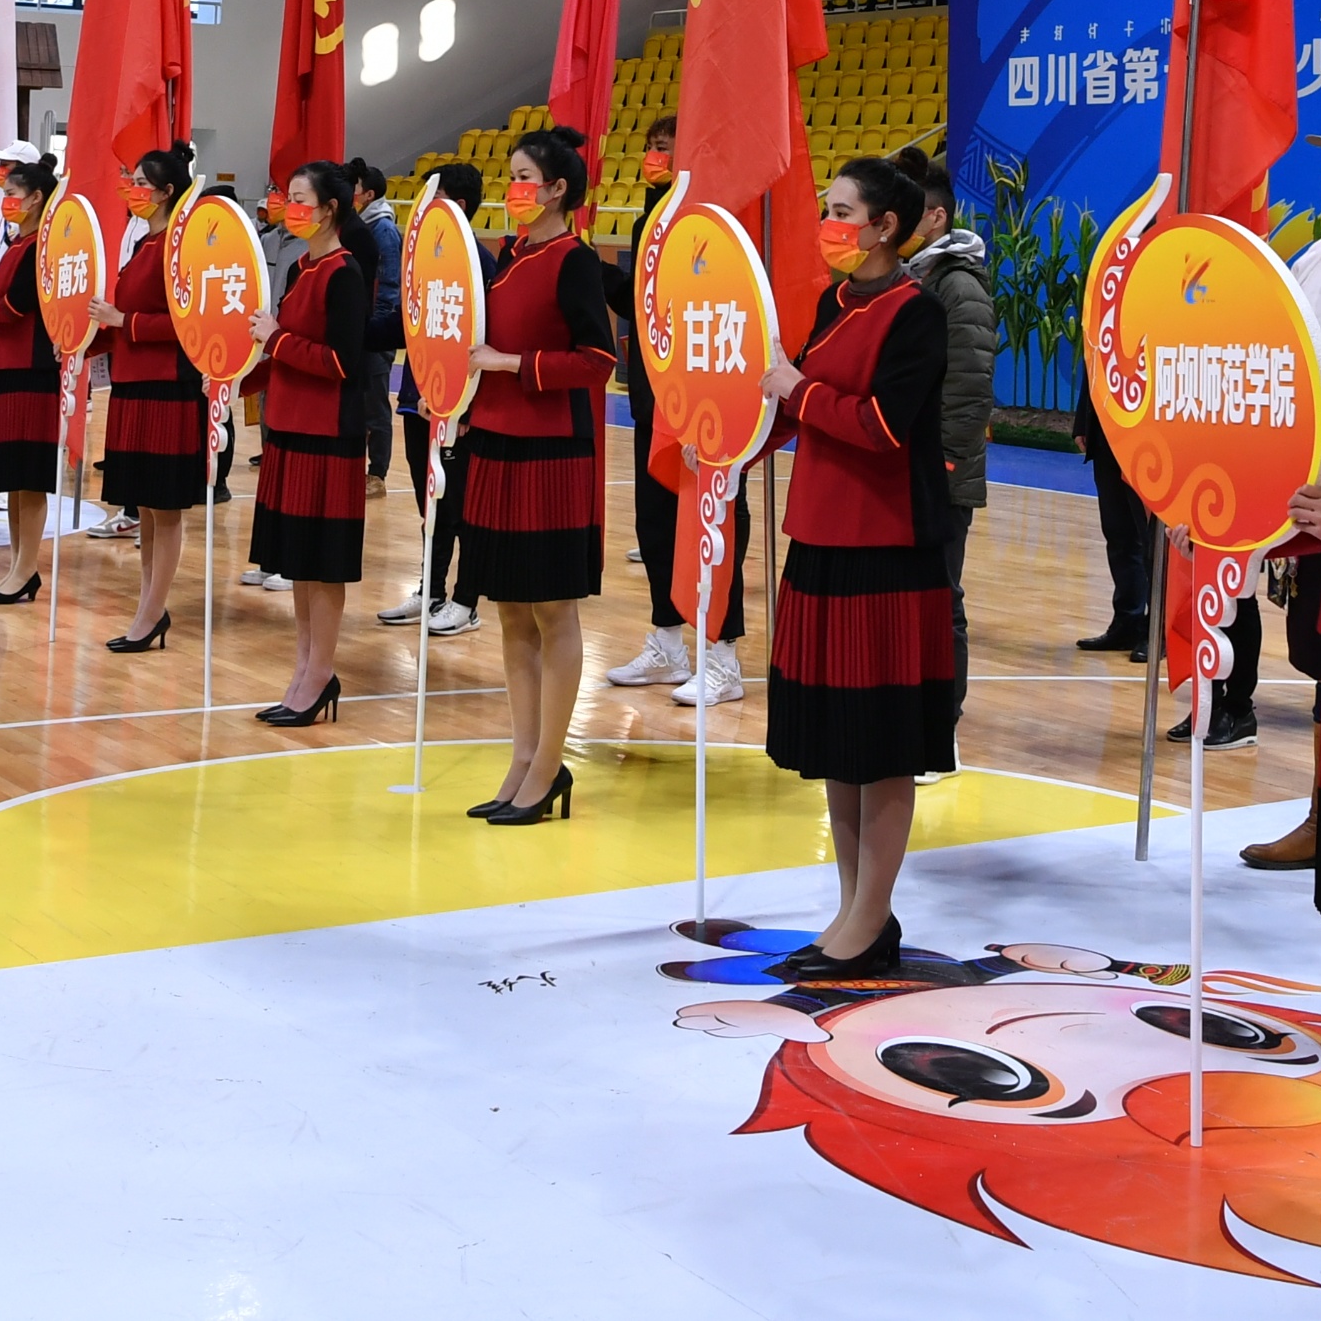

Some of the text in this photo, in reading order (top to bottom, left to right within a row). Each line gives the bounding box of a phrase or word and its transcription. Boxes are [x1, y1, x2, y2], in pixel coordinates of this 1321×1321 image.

[57, 249, 89, 299] 南充
[199, 262, 247, 316] 广安
[425, 279, 464, 343] 雅安
[682, 299, 748, 375] 甘孜
[1152, 342, 1296, 428] 阿坝师范学院
